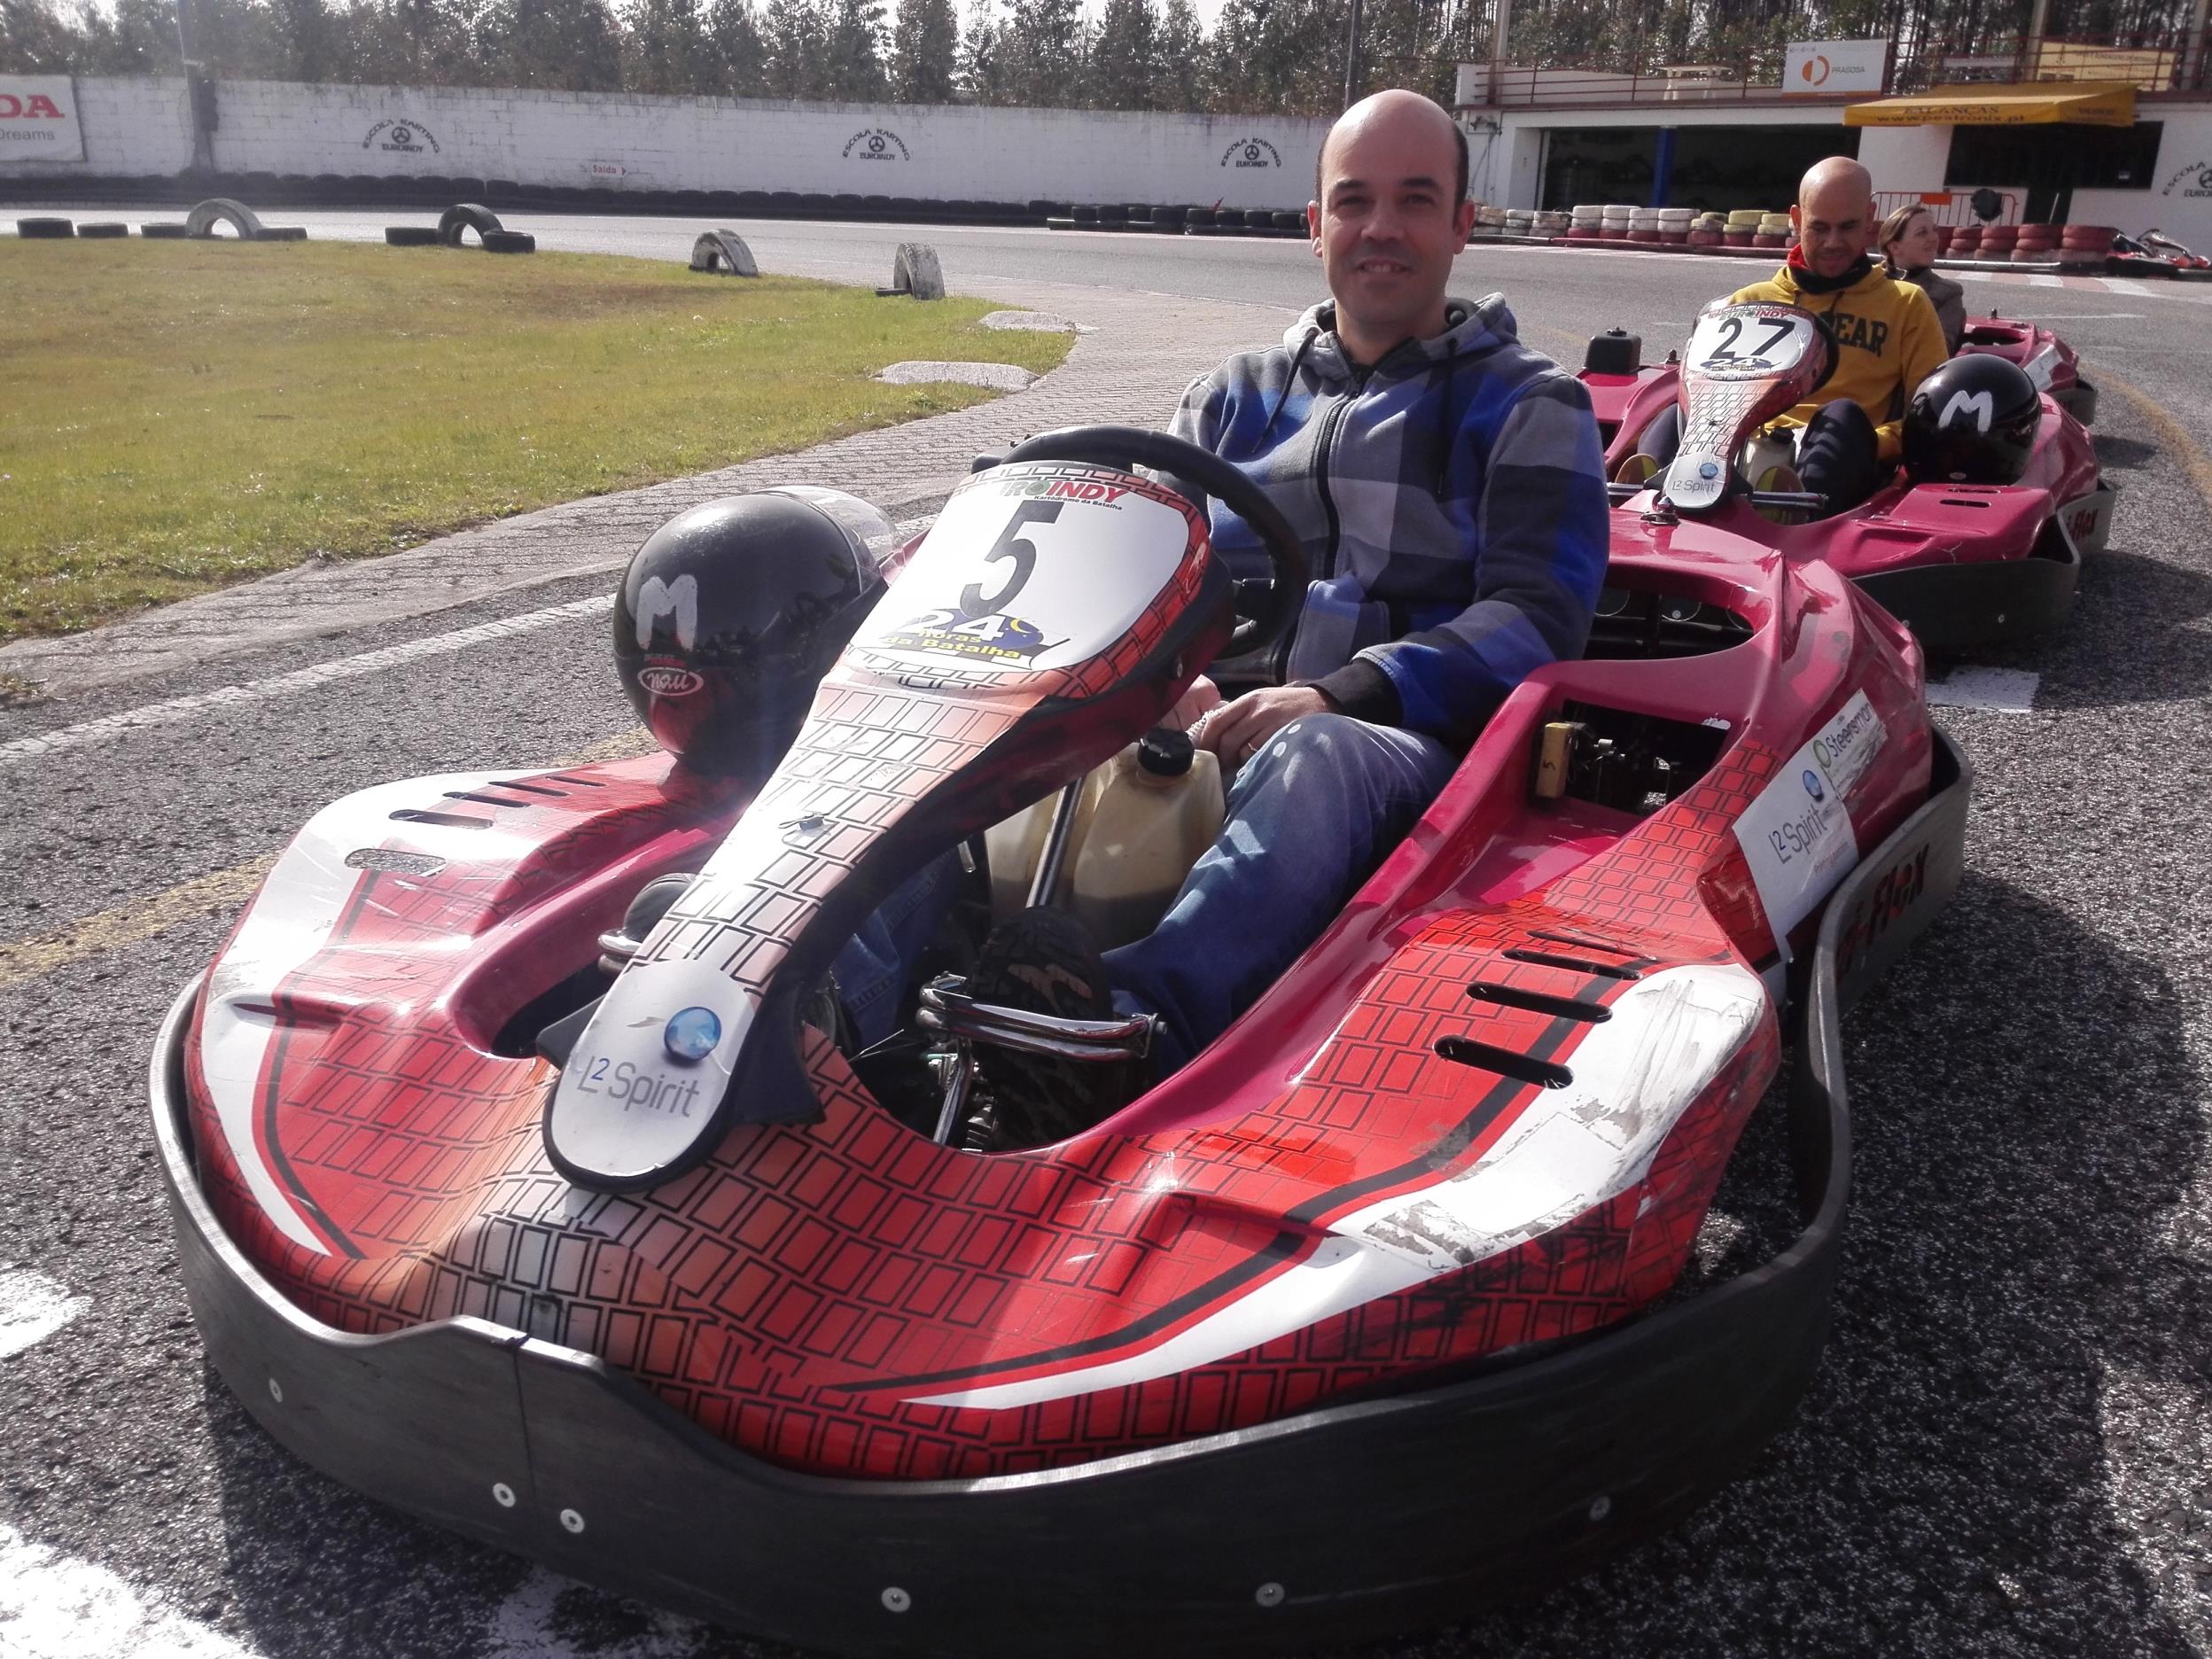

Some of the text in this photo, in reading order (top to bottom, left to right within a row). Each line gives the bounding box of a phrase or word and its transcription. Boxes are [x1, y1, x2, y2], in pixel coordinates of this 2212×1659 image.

[362, 118, 440, 153] ESCOLA KARTING
[842, 129, 910, 161] ESCOLA KARTING
[1220, 137, 1281, 167] ESCOLA KARTING
[860, 152, 896, 160] EUROINDY
[2162, 161, 2206, 196] ESCOLA
[1708, 317, 1795, 359] 27
[1937, 390, 1993, 432] M
[1683, 479, 1717, 494] Spirit
[1092, 500, 1123, 511] Batalha
[959, 500, 1064, 619] 5
[635, 573, 698, 652] M
[893, 608, 1007, 642] 24
[917, 628, 984, 643] horas
[921, 638, 1021, 659] Batalha
[1825, 702, 1873, 759] Steersman
[1781, 804, 1828, 855] Spirit
[607, 1061, 700, 1118] Spirit
